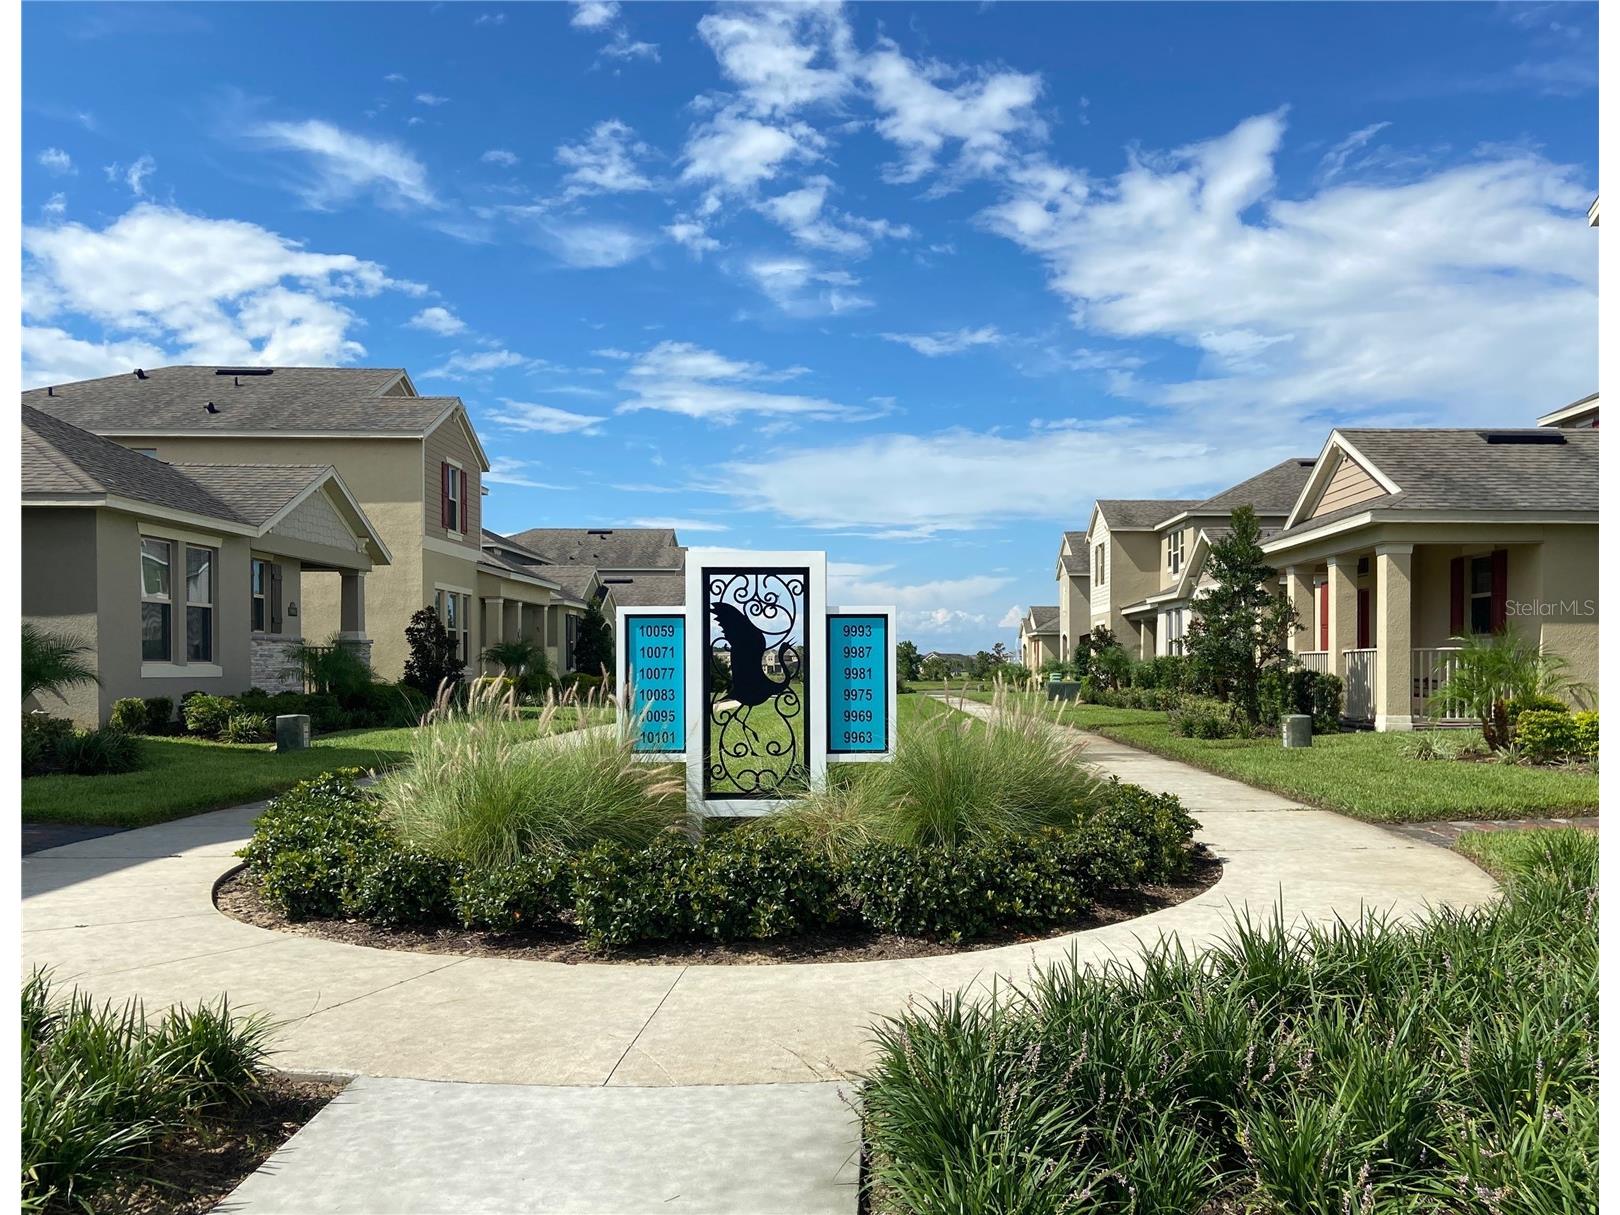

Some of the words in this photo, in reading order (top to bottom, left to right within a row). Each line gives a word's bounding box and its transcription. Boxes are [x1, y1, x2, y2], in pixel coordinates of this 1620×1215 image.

[639, 625, 675, 637] 10059
[843, 625, 872, 637] 9993
[639, 646, 675, 658] 10071
[843, 646, 872, 658] 9987
[639, 667, 675, 679] 10077
[844, 667, 872, 679] 9981
[639, 689, 675, 701] 10083
[843, 689, 872, 701] 9975
[843, 710, 872, 722] 9969
[640, 732, 675, 743] 10101
[843, 732, 872, 743] 9963
